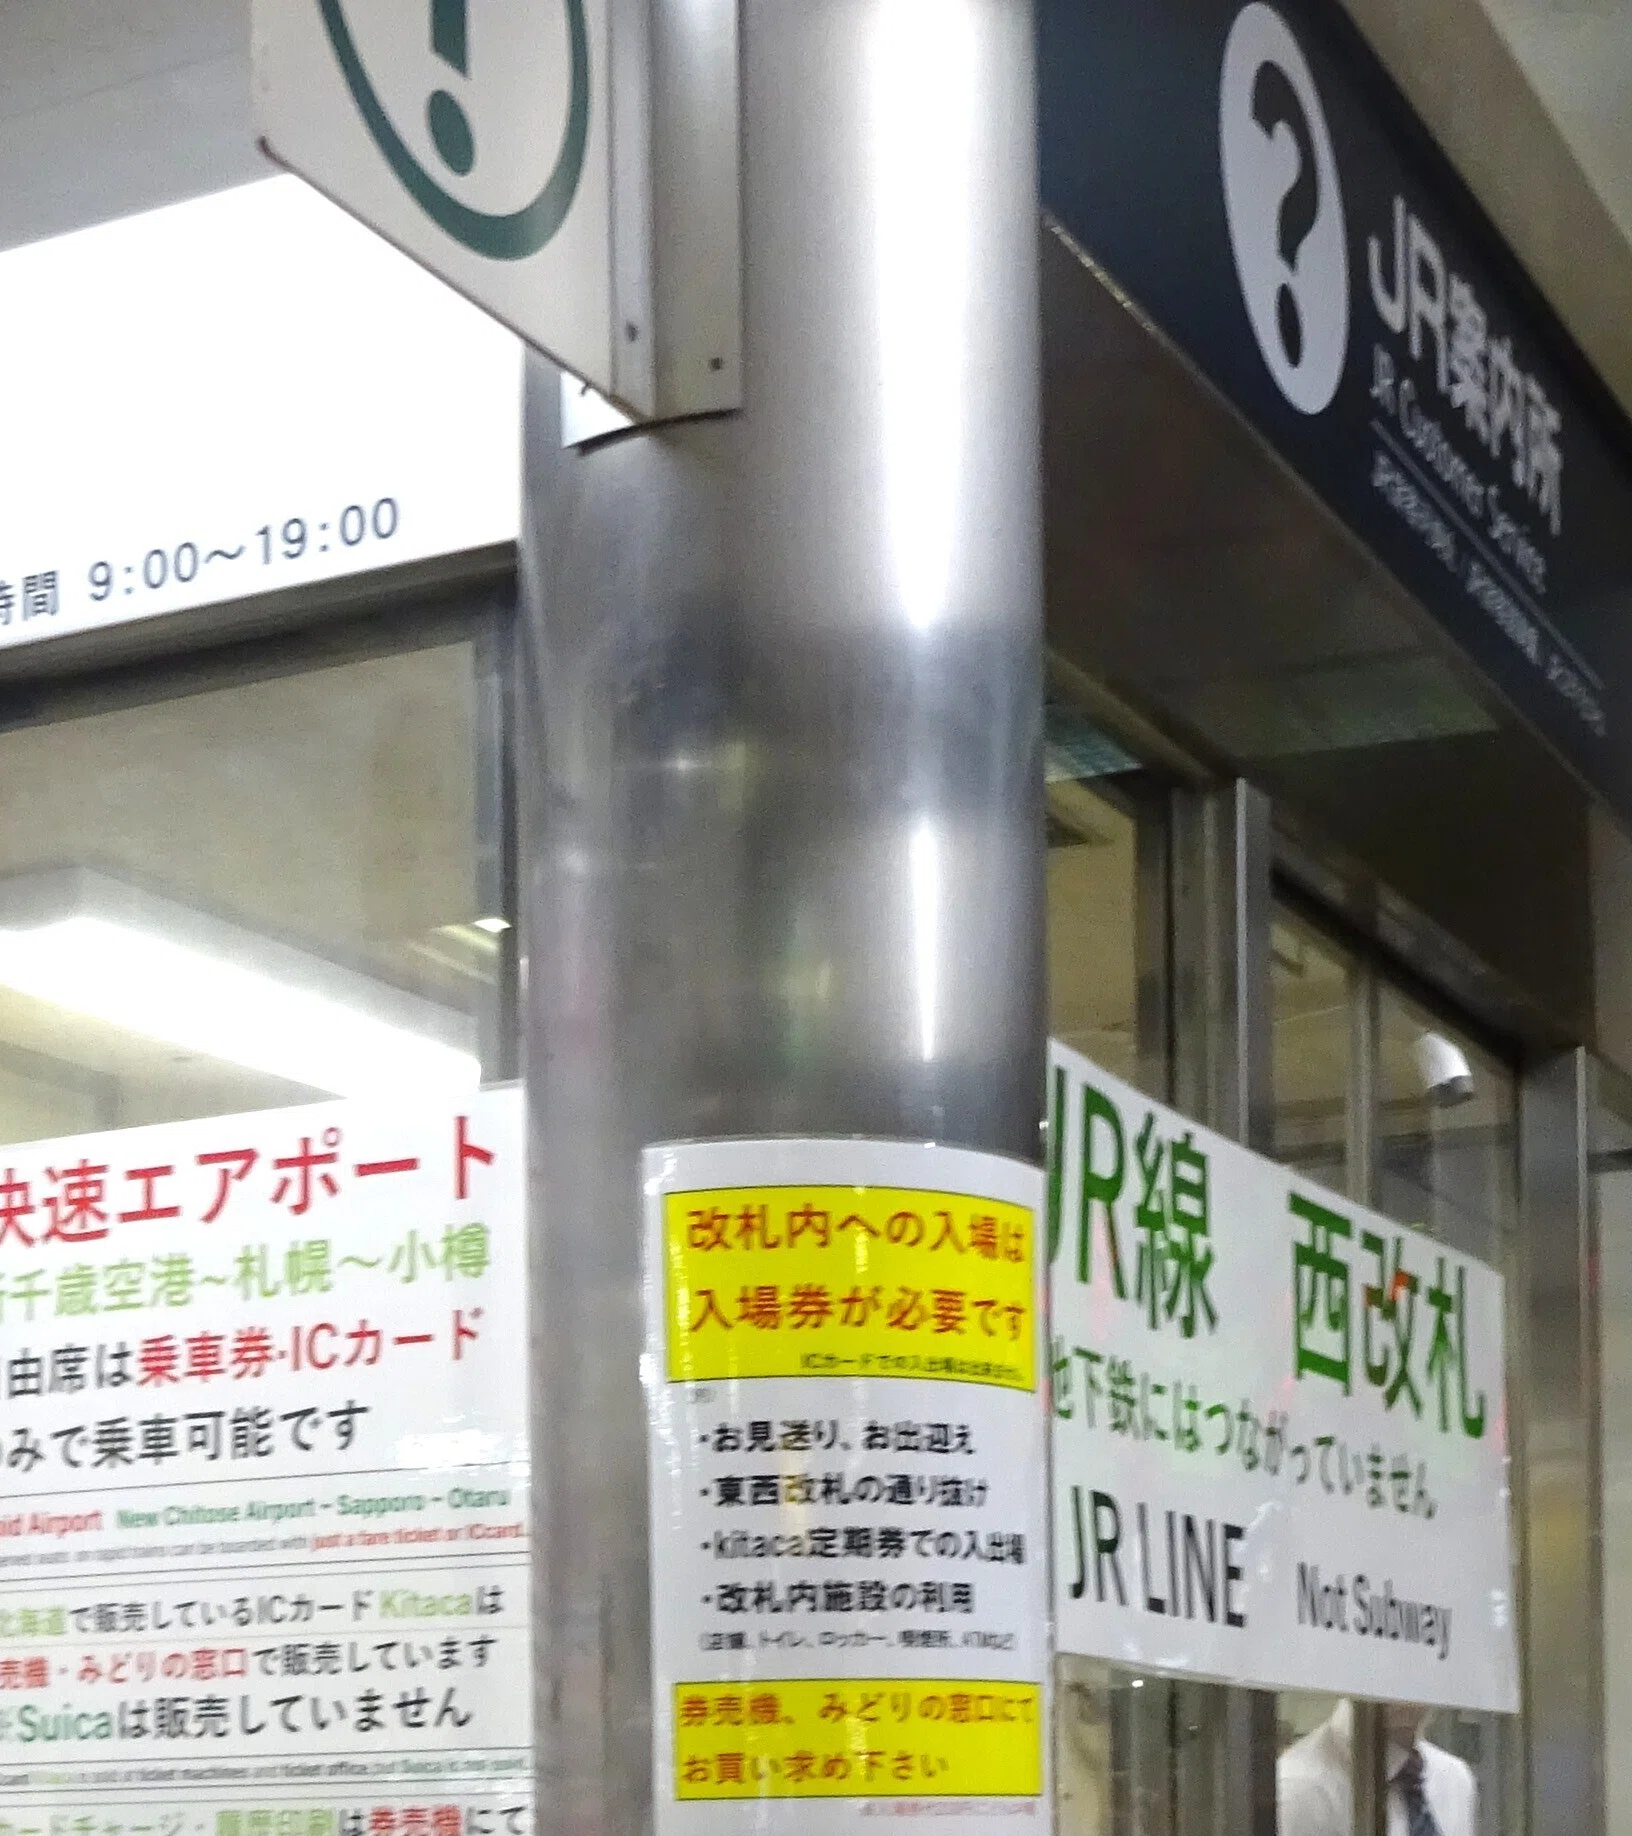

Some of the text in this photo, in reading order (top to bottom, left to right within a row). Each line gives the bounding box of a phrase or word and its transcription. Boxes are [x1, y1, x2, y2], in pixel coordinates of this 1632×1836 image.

[686, 1202, 1025, 1264] 改札内への入場は
[1048, 1065, 1486, 1439] JR線 西改札
[691, 1284, 1026, 1341] 入場券が必要です
[27, 1509, 104, 1538] Airport
[118, 1509, 159, 1529] New
[166, 1505, 240, 1526] Chitose
[245, 1499, 315, 1524] Airport
[337, 1494, 426, 1519] Sapporo
[448, 1487, 512, 1509] Otaru
[1069, 1484, 1454, 1660] JR LINE Not Subway
[682, 1752, 949, 1786] お買い求め下さい
